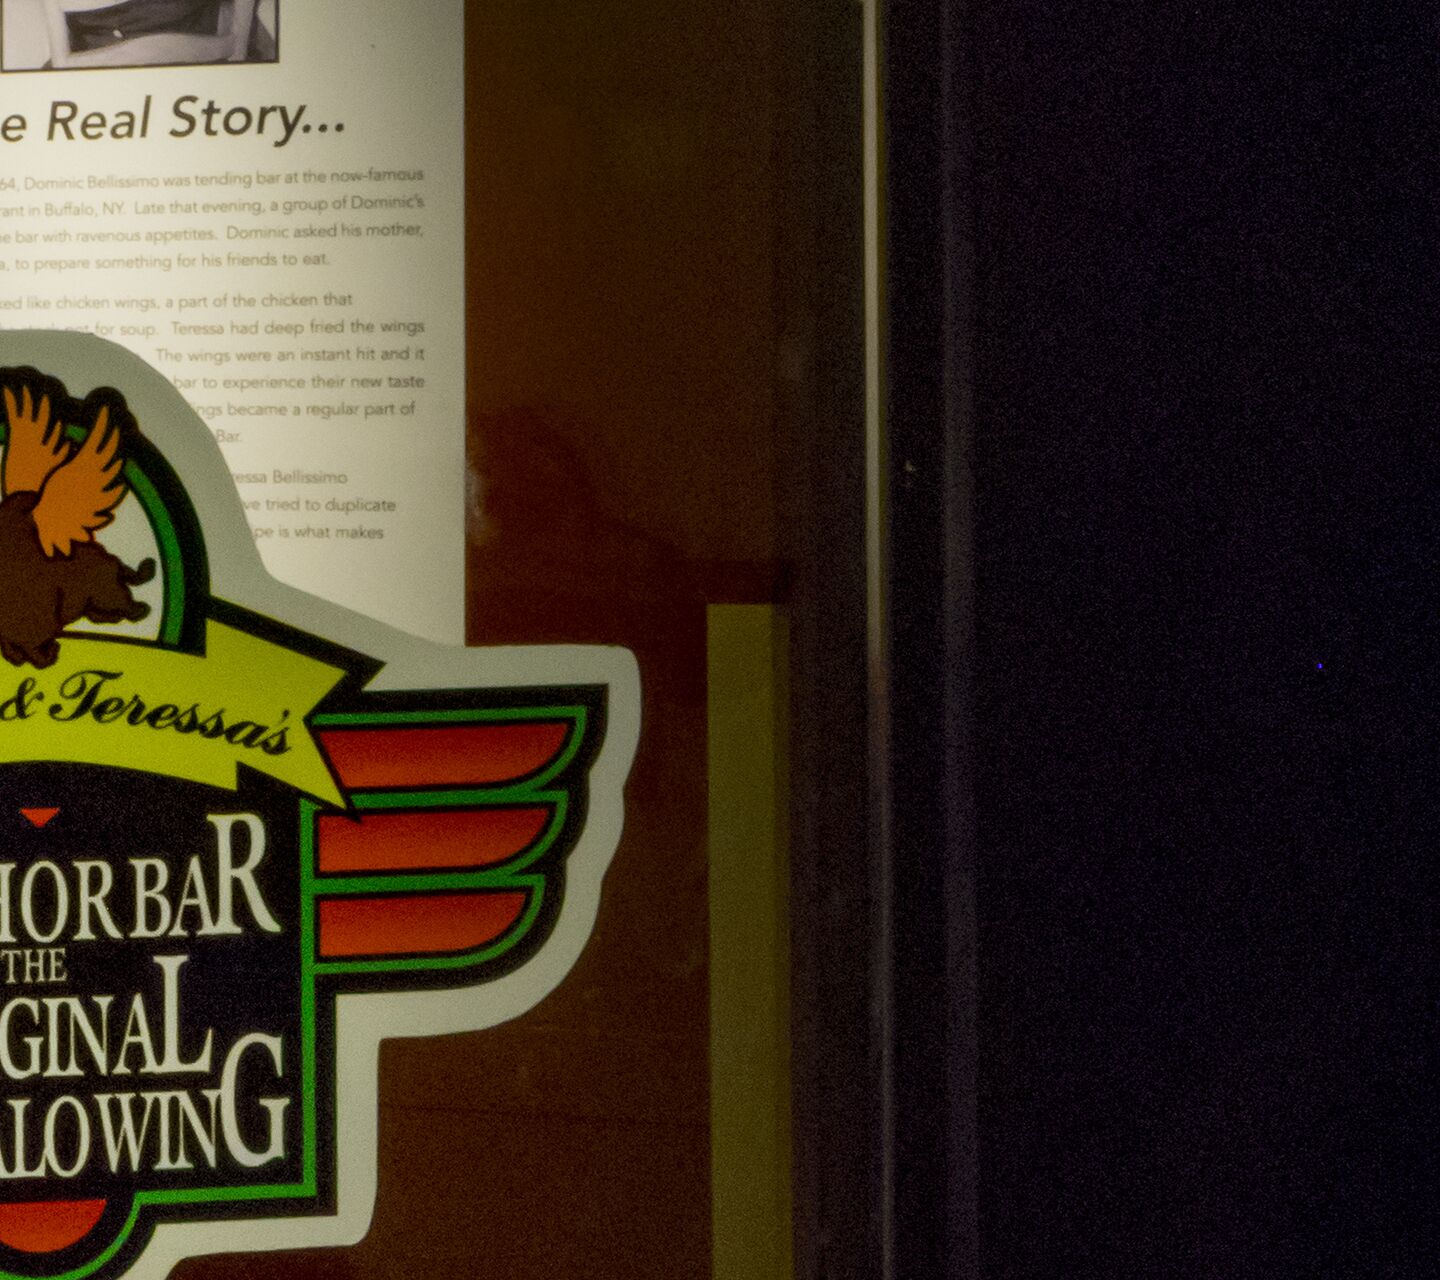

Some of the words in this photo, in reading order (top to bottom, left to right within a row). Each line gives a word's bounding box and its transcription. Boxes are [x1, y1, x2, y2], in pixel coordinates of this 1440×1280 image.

[47, 95, 152, 141] Real
[169, 95, 345, 147] Story...
[24, 176, 84, 191] Dominic
[87, 174, 159, 189] Bellissimo
[163, 176, 191, 188] was
[194, 172, 252, 189] tending
[256, 171, 281, 185] bar
[284, 171, 298, 184] at
[302, 169, 326, 184] the
[330, 167, 424, 182] now-famous
[28, 204, 40, 217] in
[45, 201, 98, 218] Buffalo,
[103, 201, 126, 215] NY.
[135, 201, 165, 214] Late
[169, 199, 197, 213] that
[202, 199, 265, 216] evening,
[270, 200, 278, 211] a
[282, 199, 328, 215] group
[332, 195, 350, 210] of
[351, 194, 425, 210] Dominic's
[15, 230, 38, 244] bar
[42, 229, 72, 243] with
[76, 231, 140, 243] ravenous
[145, 228, 218, 245] appetites.
[227, 225, 289, 240] Dominic
[293, 224, 337, 238] asked
[341, 223, 362, 237] his
[366, 222, 424, 238] mother,
[15, 259, 30, 270] to
[34, 259, 90, 274] prepare
[96, 256, 172, 272] something
[177, 254, 196, 268] for
[202, 253, 222, 267] his
[227, 252, 277, 267] friends
[282, 253, 298, 266] to
[302, 253, 329, 266] eat.
[27, 295, 51, 310] like
[56, 294, 110, 309] chicken
[114, 294, 160, 312] wings,
[165, 297, 173, 308] a
[178, 296, 208, 312] part
[212, 293, 228, 307] of
[233, 293, 256, 307] the
[261, 292, 318, 307] chicken
[323, 291, 353, 306] that
[95, 323, 114, 336] for
[120, 324, 159, 339] soup.
[171, 321, 224, 335] Teressa
[230, 320, 258, 334] had
[264, 320, 304, 337] deep
[310, 319, 344, 334] fried
[350, 319, 374, 333] the
[380, 320, 425, 336] wings
[156, 348, 182, 362] The
[188, 348, 231, 365] wings
[236, 350, 271, 361] were
[277, 350, 295, 361] an
[301, 347, 351, 361] instant
[356, 347, 375, 361] hit
[380, 347, 409, 361] and
[415, 347, 425, 360] it
[173, 374, 196, 389] bar
[202, 377, 217, 389] to
[222, 377, 305, 393] experience
[311, 375, 345, 389] their
[351, 377, 381, 389] new
[388, 375, 425, 389] taste
[228, 402, 287, 416] became
[293, 406, 301, 415] a
[306, 402, 359, 419] regular
[364, 402, 395, 419] part
[400, 400, 416, 415] of
[216, 428, 242, 442] Bar.
[273, 469, 348, 484] Bellissimo
[266, 497, 300, 512] tried
[305, 499, 320, 511] to
[325, 497, 396, 515] duplicate
[279, 525, 290, 538] is
[294, 524, 330, 538] what
[335, 523, 384, 539] makes
[48, 669, 292, 755] Teressa's
[0, 948, 68, 983] THE
